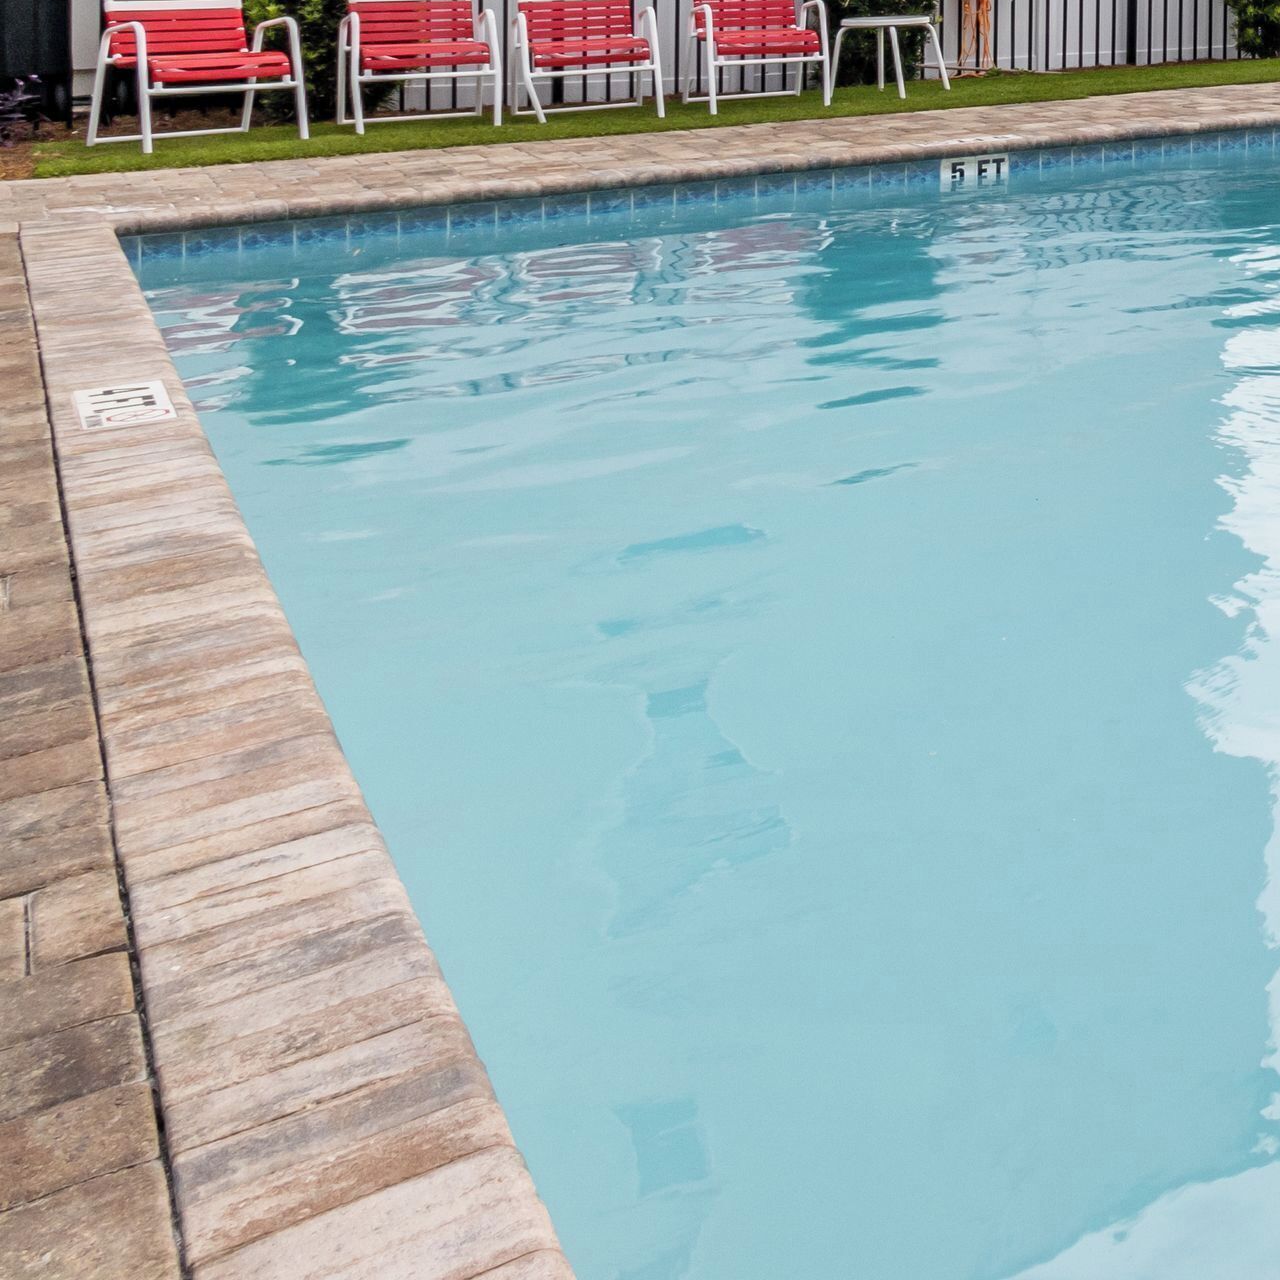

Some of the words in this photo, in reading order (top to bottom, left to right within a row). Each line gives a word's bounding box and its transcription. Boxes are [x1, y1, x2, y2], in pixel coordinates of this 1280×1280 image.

[951, 161, 965, 180] 5
[977, 158, 1006, 179] FT
[87, 386, 150, 398] 4
